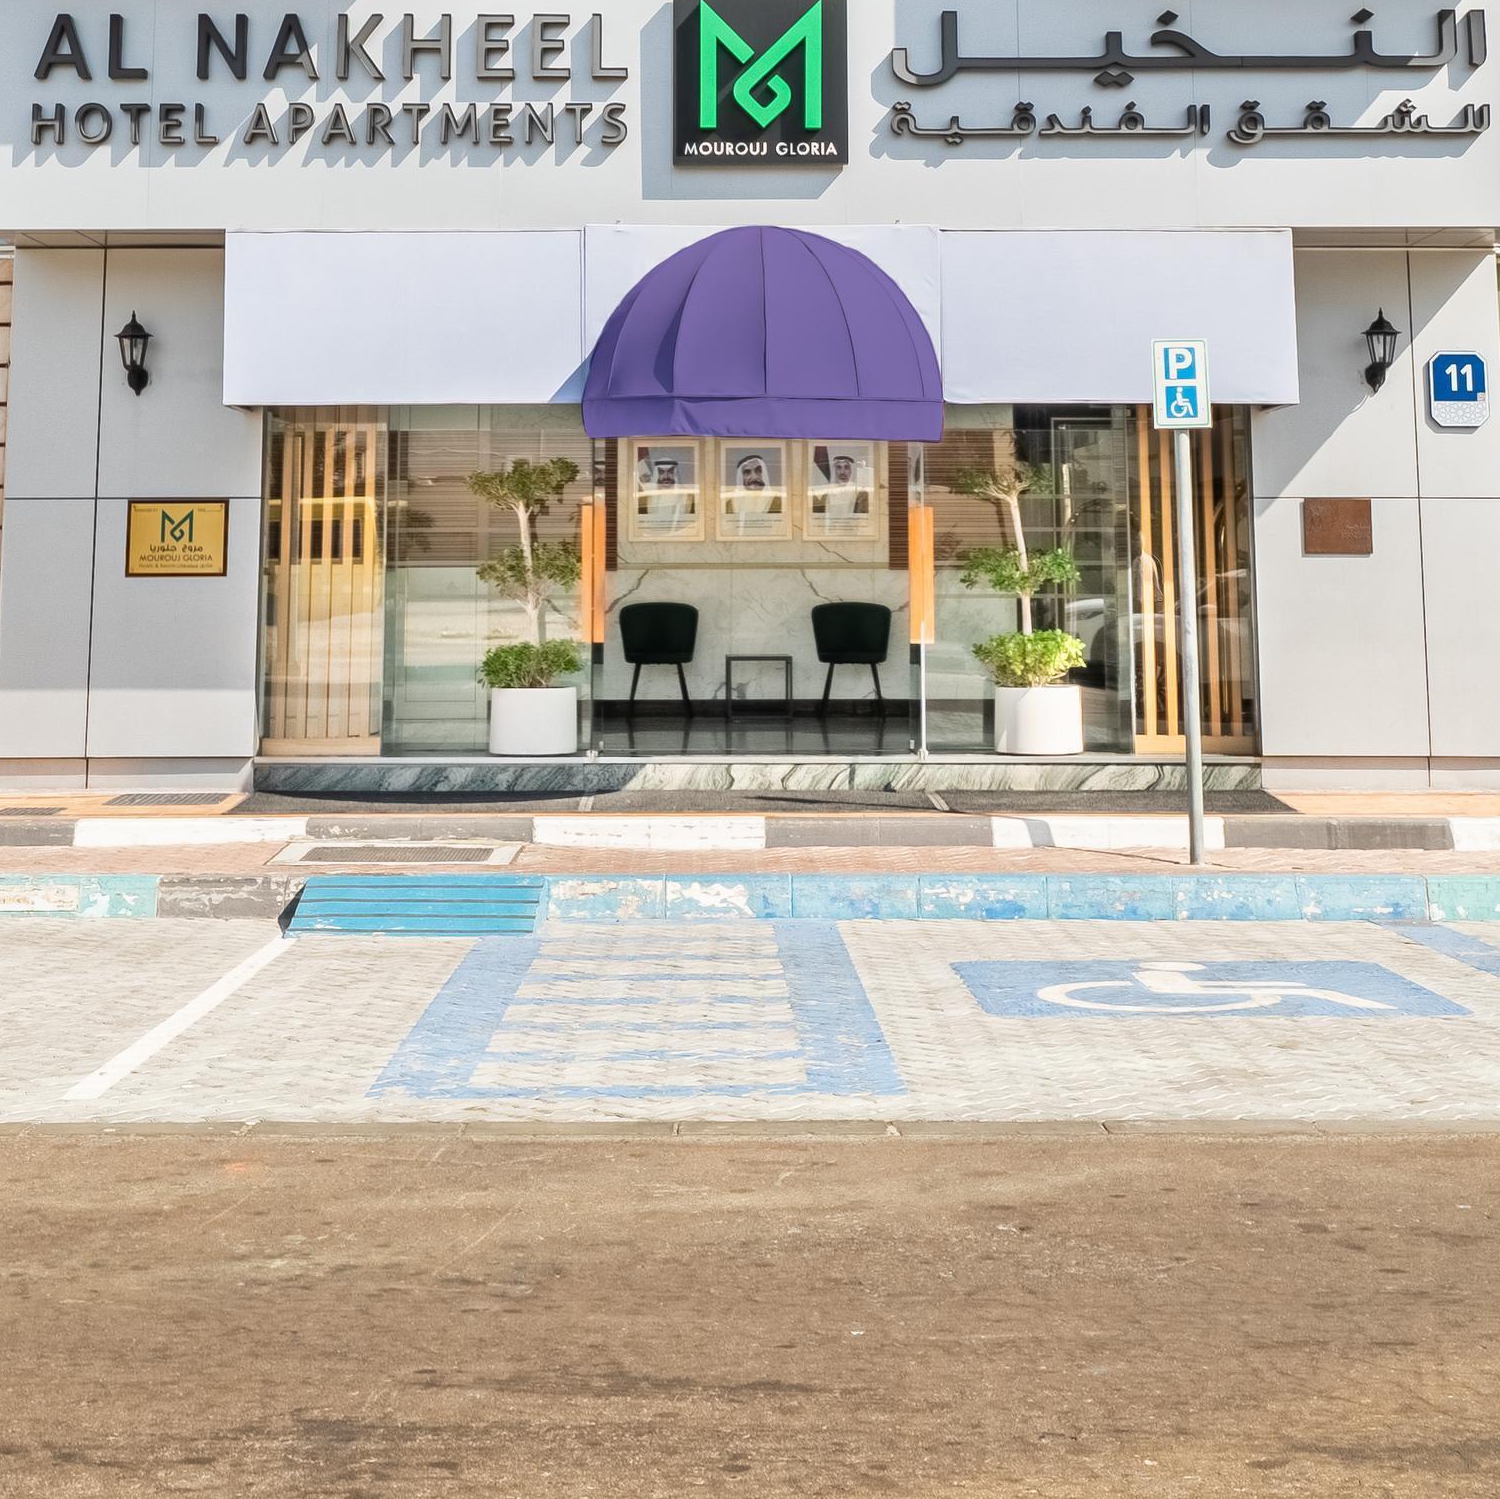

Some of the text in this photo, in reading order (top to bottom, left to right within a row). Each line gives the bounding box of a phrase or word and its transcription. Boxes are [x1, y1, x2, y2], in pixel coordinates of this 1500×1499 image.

[34, 13, 628, 80] AL NAKHEEL
[891, 8, 1488, 87] النخيل
[30, 102, 628, 145] HOTEL APARTMENTS
[890, 100, 1490, 145] للشقق الفندقية
[684, 141, 838, 156] MOUROUJ GLORIA
[1168, 347, 1193, 379] P
[1445, 364, 1473, 392] 11
[140, 554, 213, 562] MOUROUJ GLORIA
